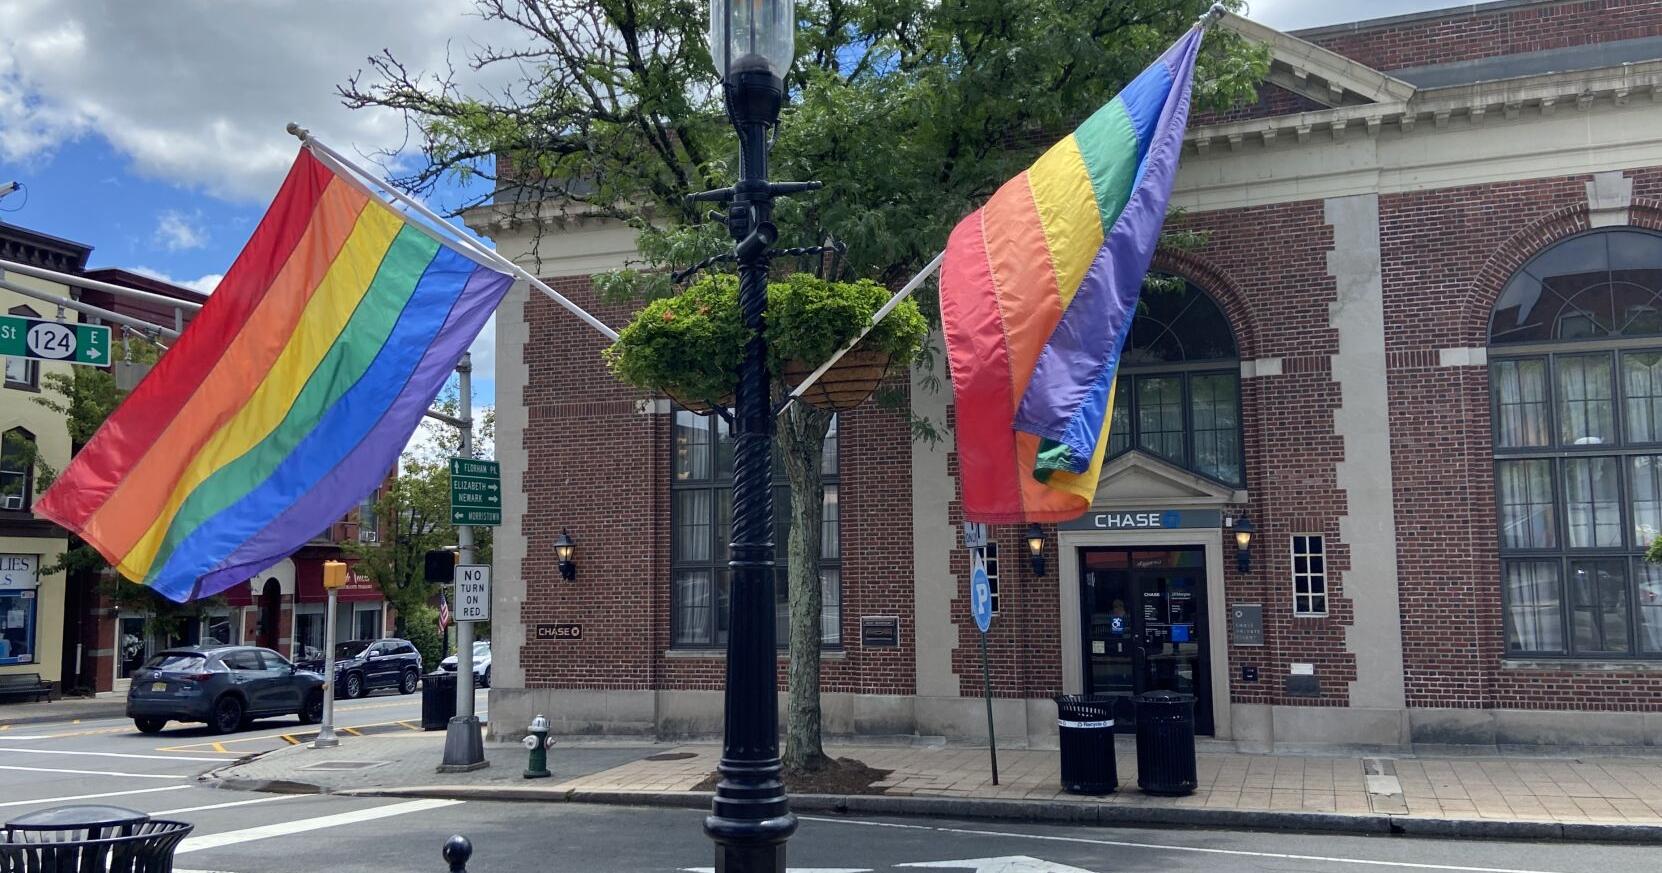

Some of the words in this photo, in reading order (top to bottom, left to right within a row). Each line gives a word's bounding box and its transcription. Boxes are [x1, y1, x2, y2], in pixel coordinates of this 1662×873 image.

[1, 325, 17, 340] St
[90, 331, 98, 344] E
[34, 330, 71, 352] 124
[453, 480, 487, 491] ELIZABETH
[458, 493, 483, 503] NEWARK
[1094, 513, 1161, 528] CHASE
[464, 570, 481, 581] NO
[461, 583, 485, 593] TURN
[466, 595, 479, 605] ON
[976, 583, 988, 615] P
[463, 607, 481, 616] RED
[538, 627, 570, 636] CHASE
